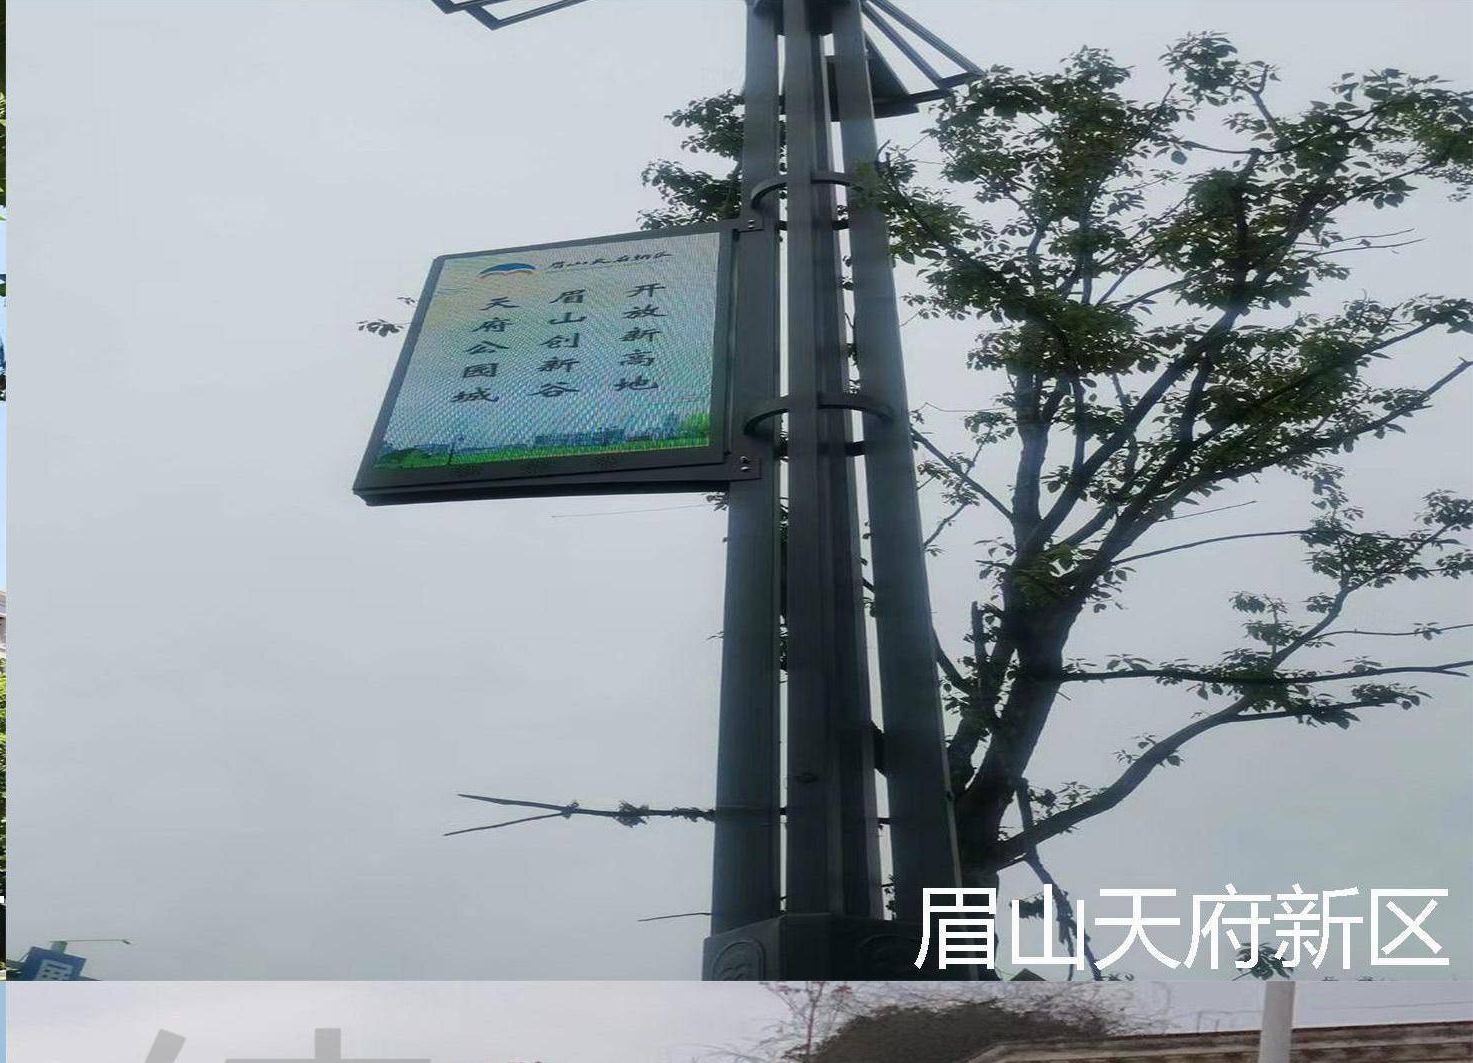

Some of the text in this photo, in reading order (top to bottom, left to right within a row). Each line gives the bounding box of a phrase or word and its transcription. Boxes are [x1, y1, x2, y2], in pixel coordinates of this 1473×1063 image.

[451, 296, 520, 403] 天府公园城
[529, 288, 587, 399] 眉山创新谷
[613, 282, 668, 392] 开放新高地
